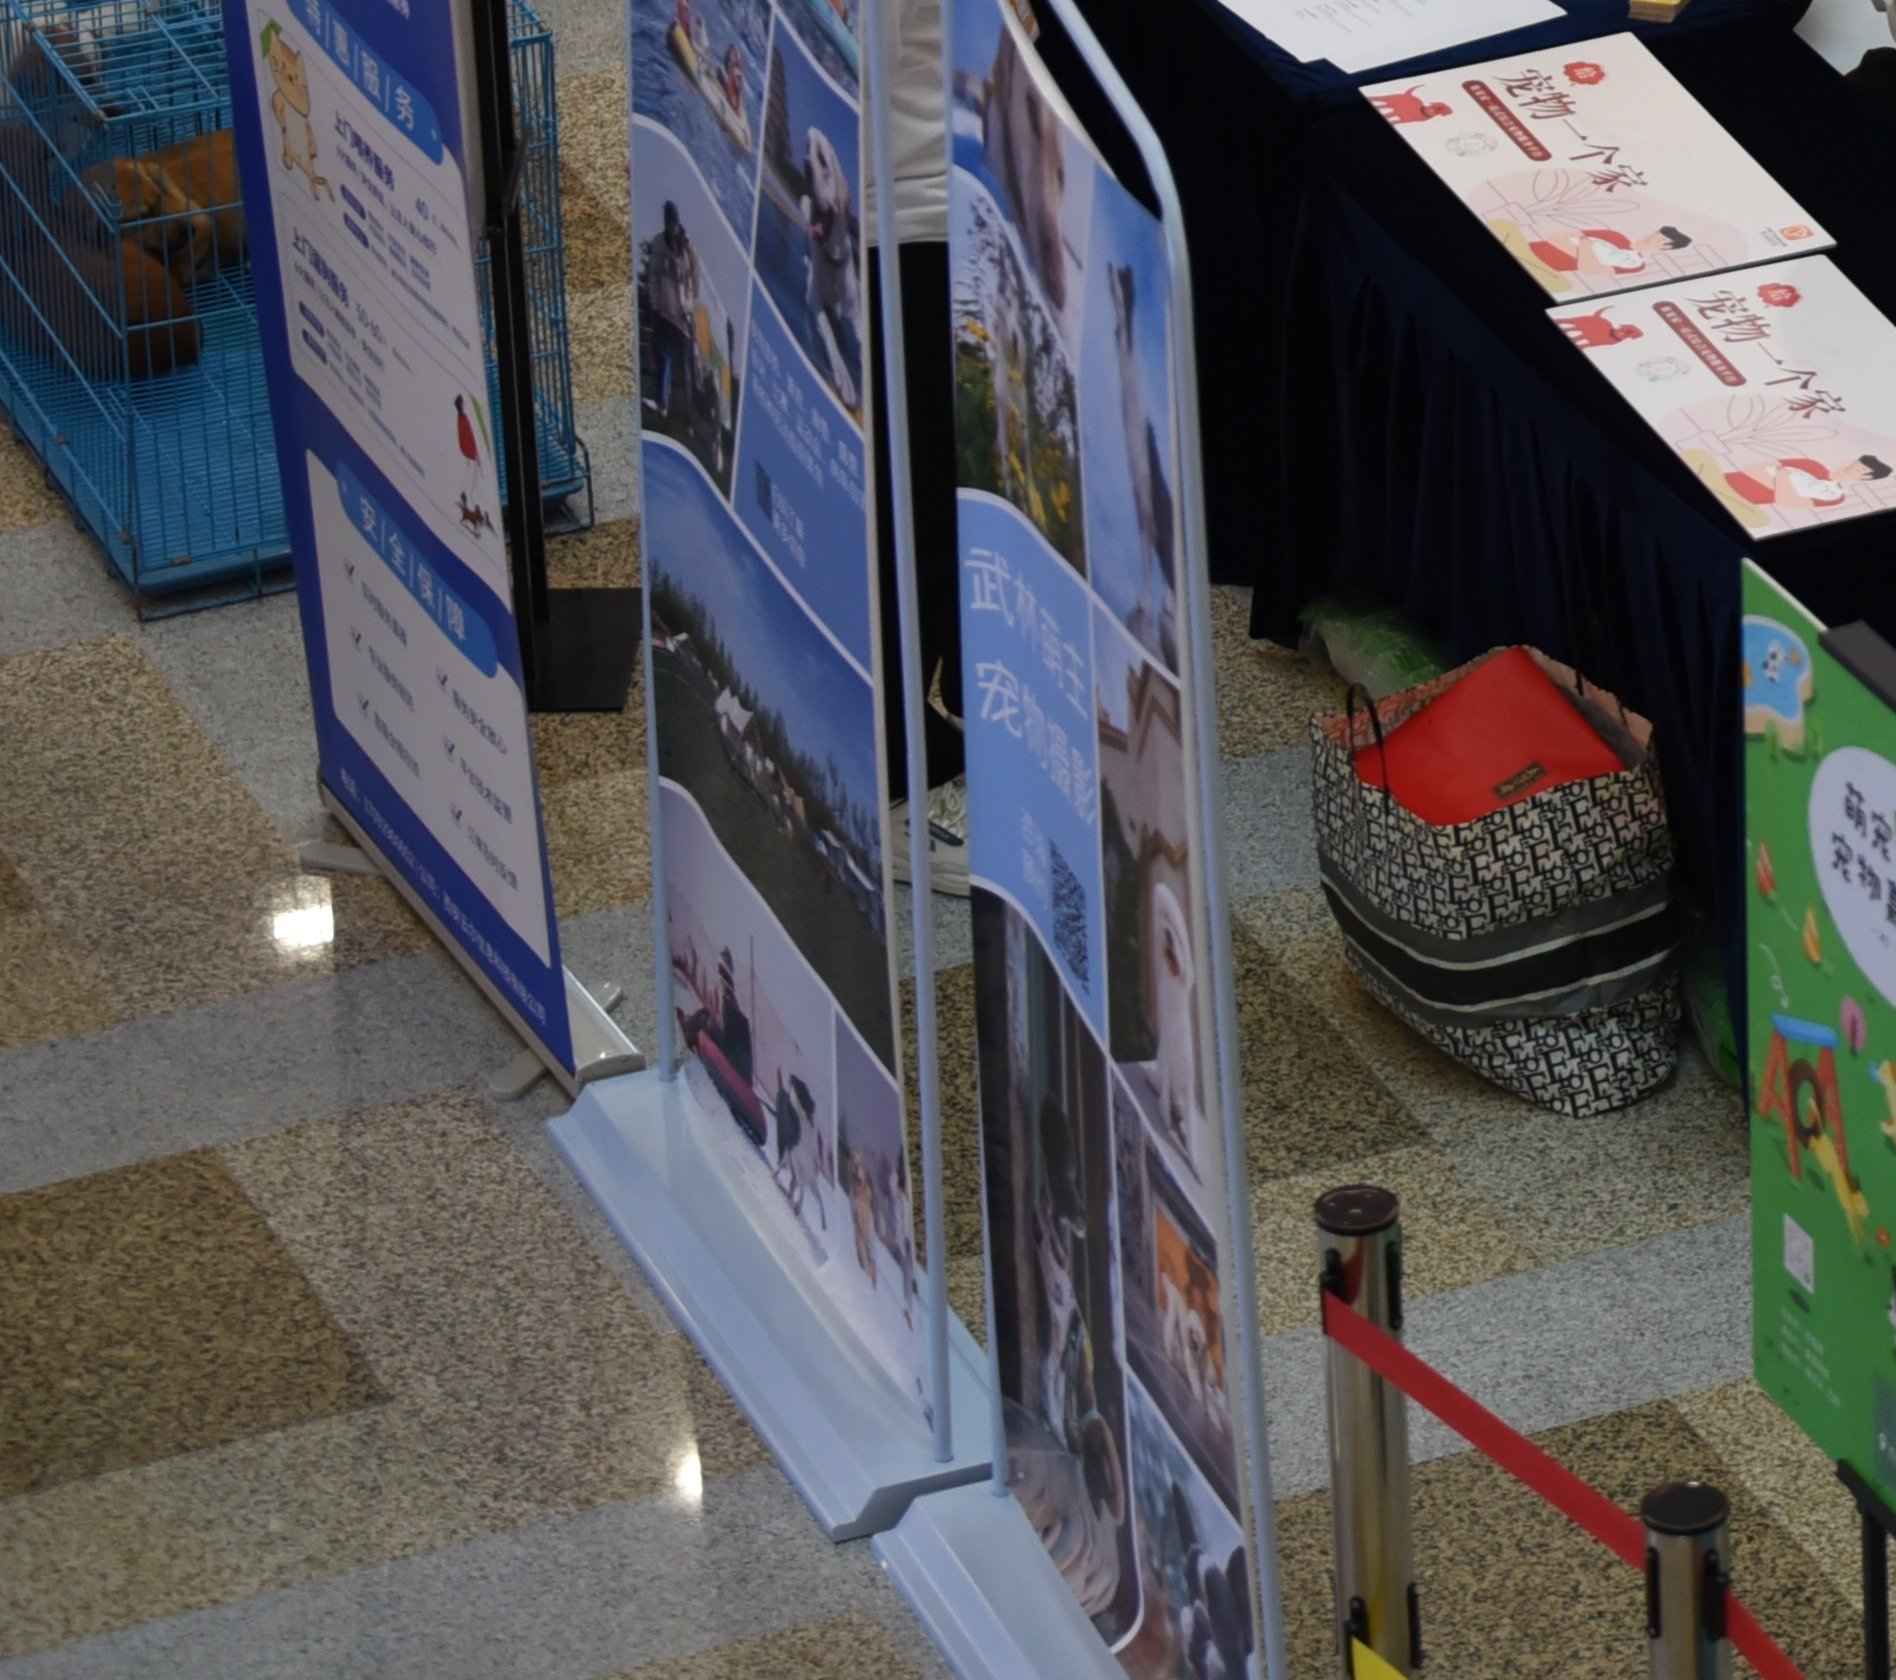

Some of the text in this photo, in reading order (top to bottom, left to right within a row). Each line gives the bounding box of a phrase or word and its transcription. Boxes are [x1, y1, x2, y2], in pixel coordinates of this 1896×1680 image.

[1492, 68, 1649, 193] 宠物一个家
[1683, 289, 1847, 420] 宠物一个家
